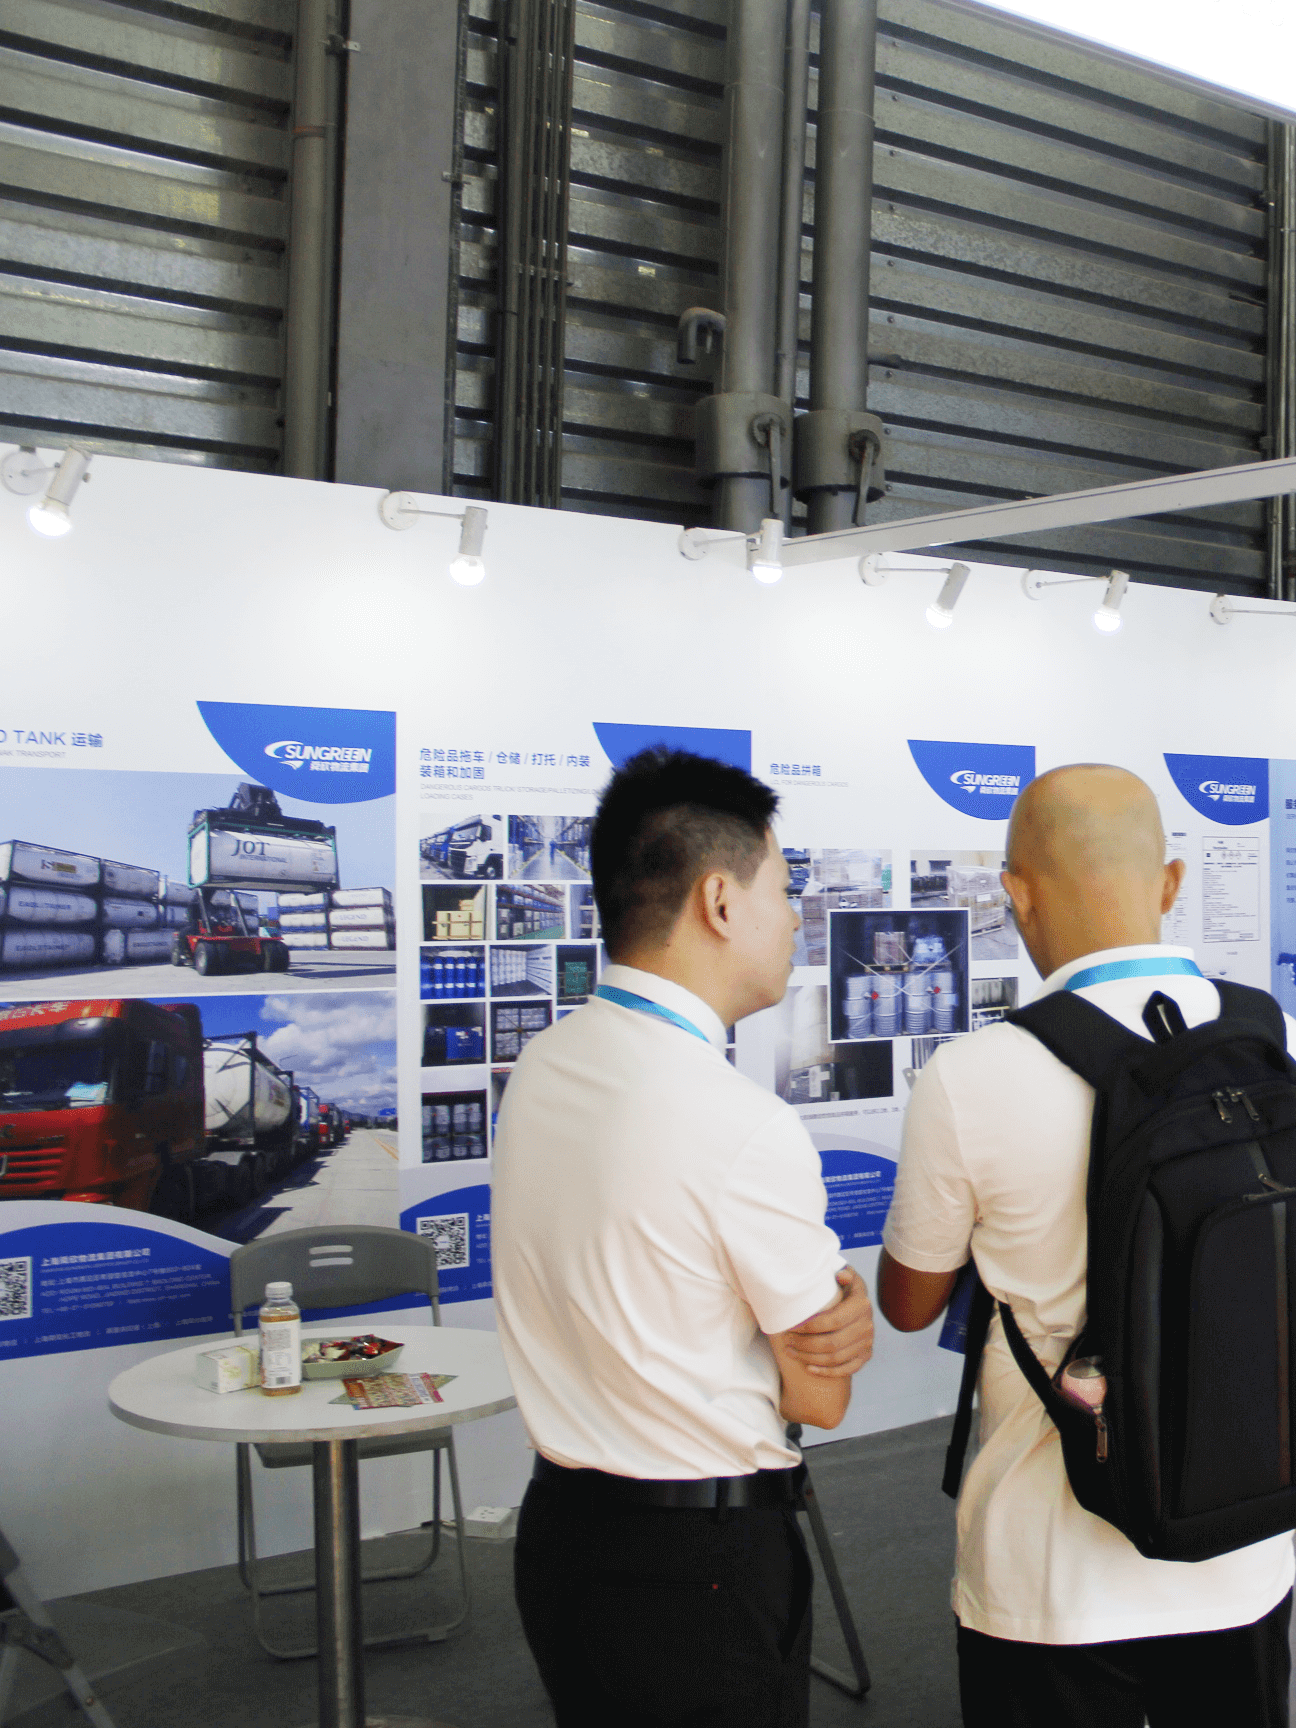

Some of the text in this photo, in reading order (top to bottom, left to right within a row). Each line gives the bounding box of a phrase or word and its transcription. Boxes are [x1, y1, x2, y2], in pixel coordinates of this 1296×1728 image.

[13, 730, 67, 746] TANK
[71, 732, 103, 748] 运输
[284, 745, 372, 763] SUNGREEN
[419, 747, 485, 763] 危险品拖车
[496, 751, 521, 765] 仓储
[531, 753, 556, 767] 打托
[419, 765, 485, 780] 装箱和加固
[963, 774, 1021, 787] SUNGREEN
[1209, 783, 1257, 795] SUNGREEN
